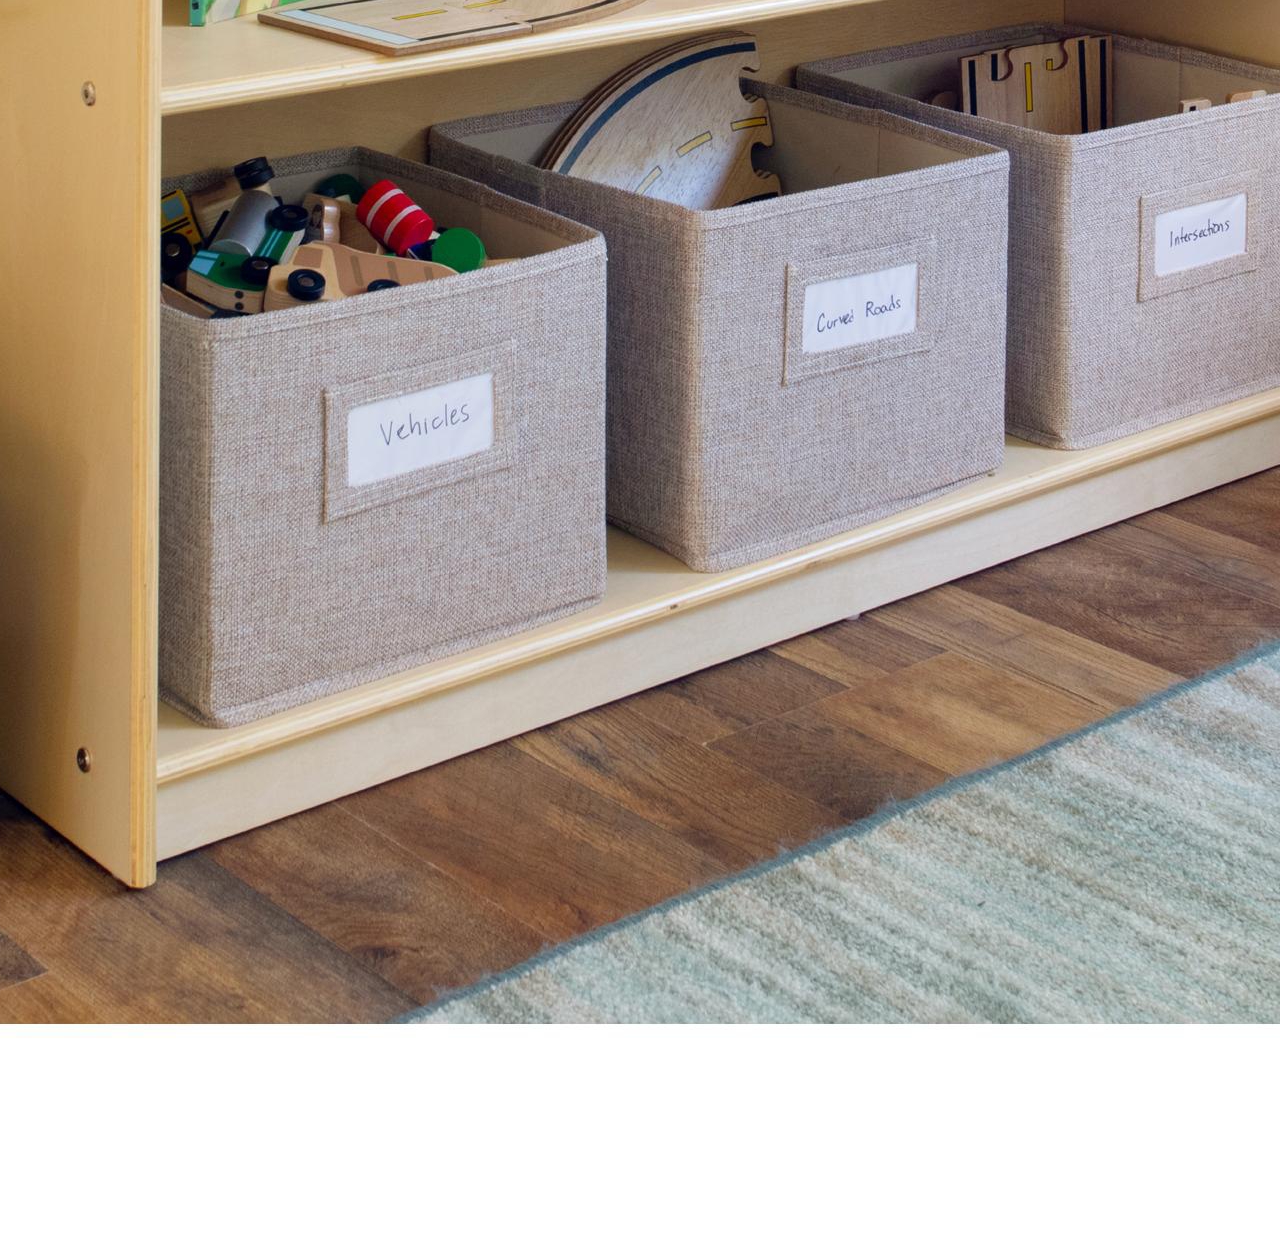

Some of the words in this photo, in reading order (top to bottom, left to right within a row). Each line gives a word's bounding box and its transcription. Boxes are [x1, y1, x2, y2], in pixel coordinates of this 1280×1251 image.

[1170, 218, 1230, 247] Intersections
[817, 309, 854, 333] Curved
[865, 294, 901, 317] Roads
[380, 403, 470, 445] Vehicles
